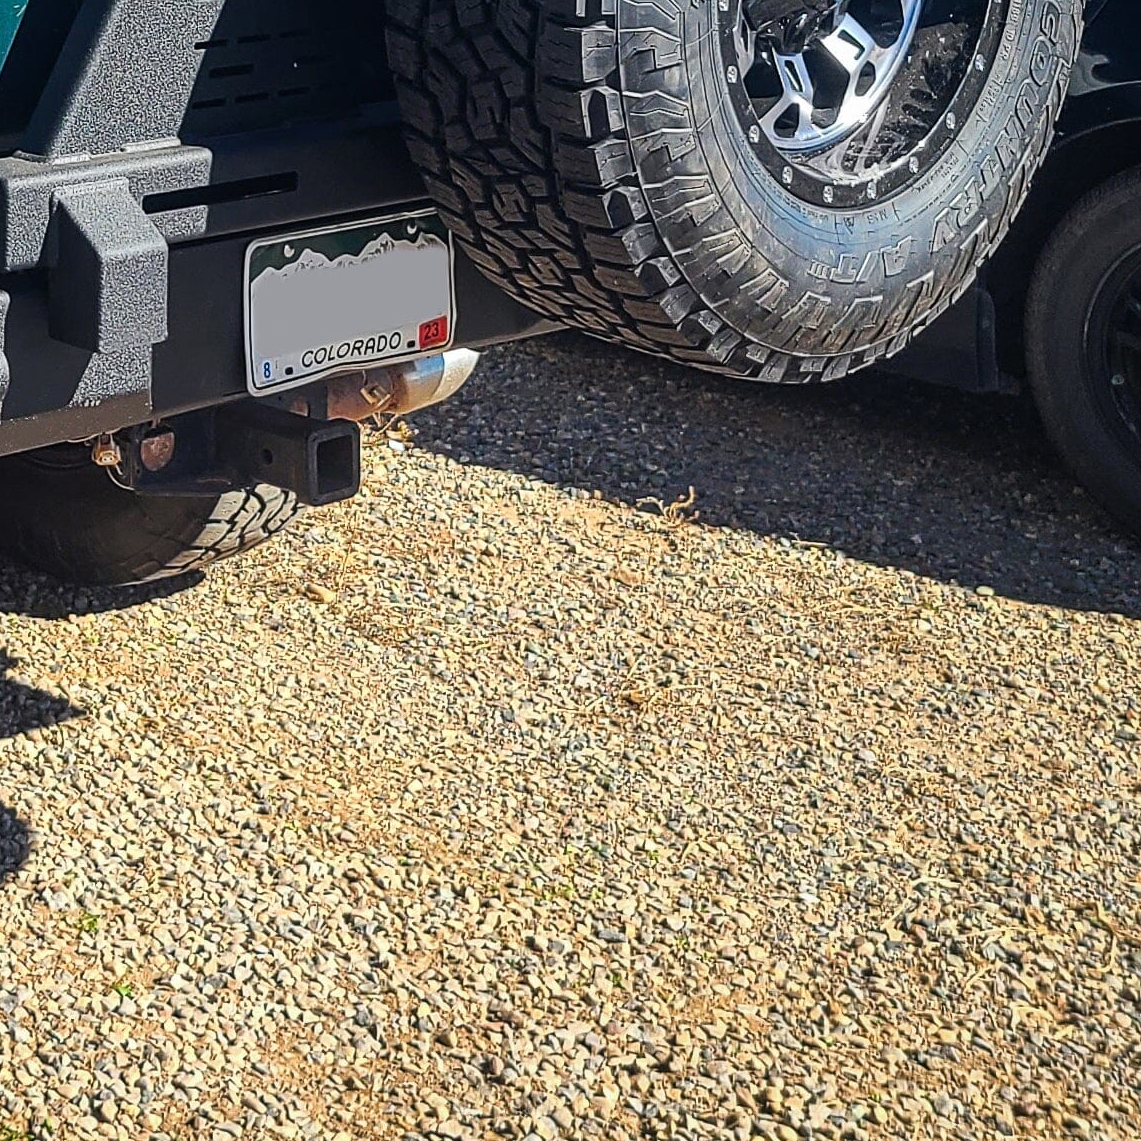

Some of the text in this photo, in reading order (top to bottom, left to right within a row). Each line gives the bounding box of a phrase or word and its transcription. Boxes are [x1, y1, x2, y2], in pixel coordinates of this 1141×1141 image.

[423, 322, 440, 341] 23
[301, 331, 402, 369] COLORADO
[263, 361, 272, 380] 8
